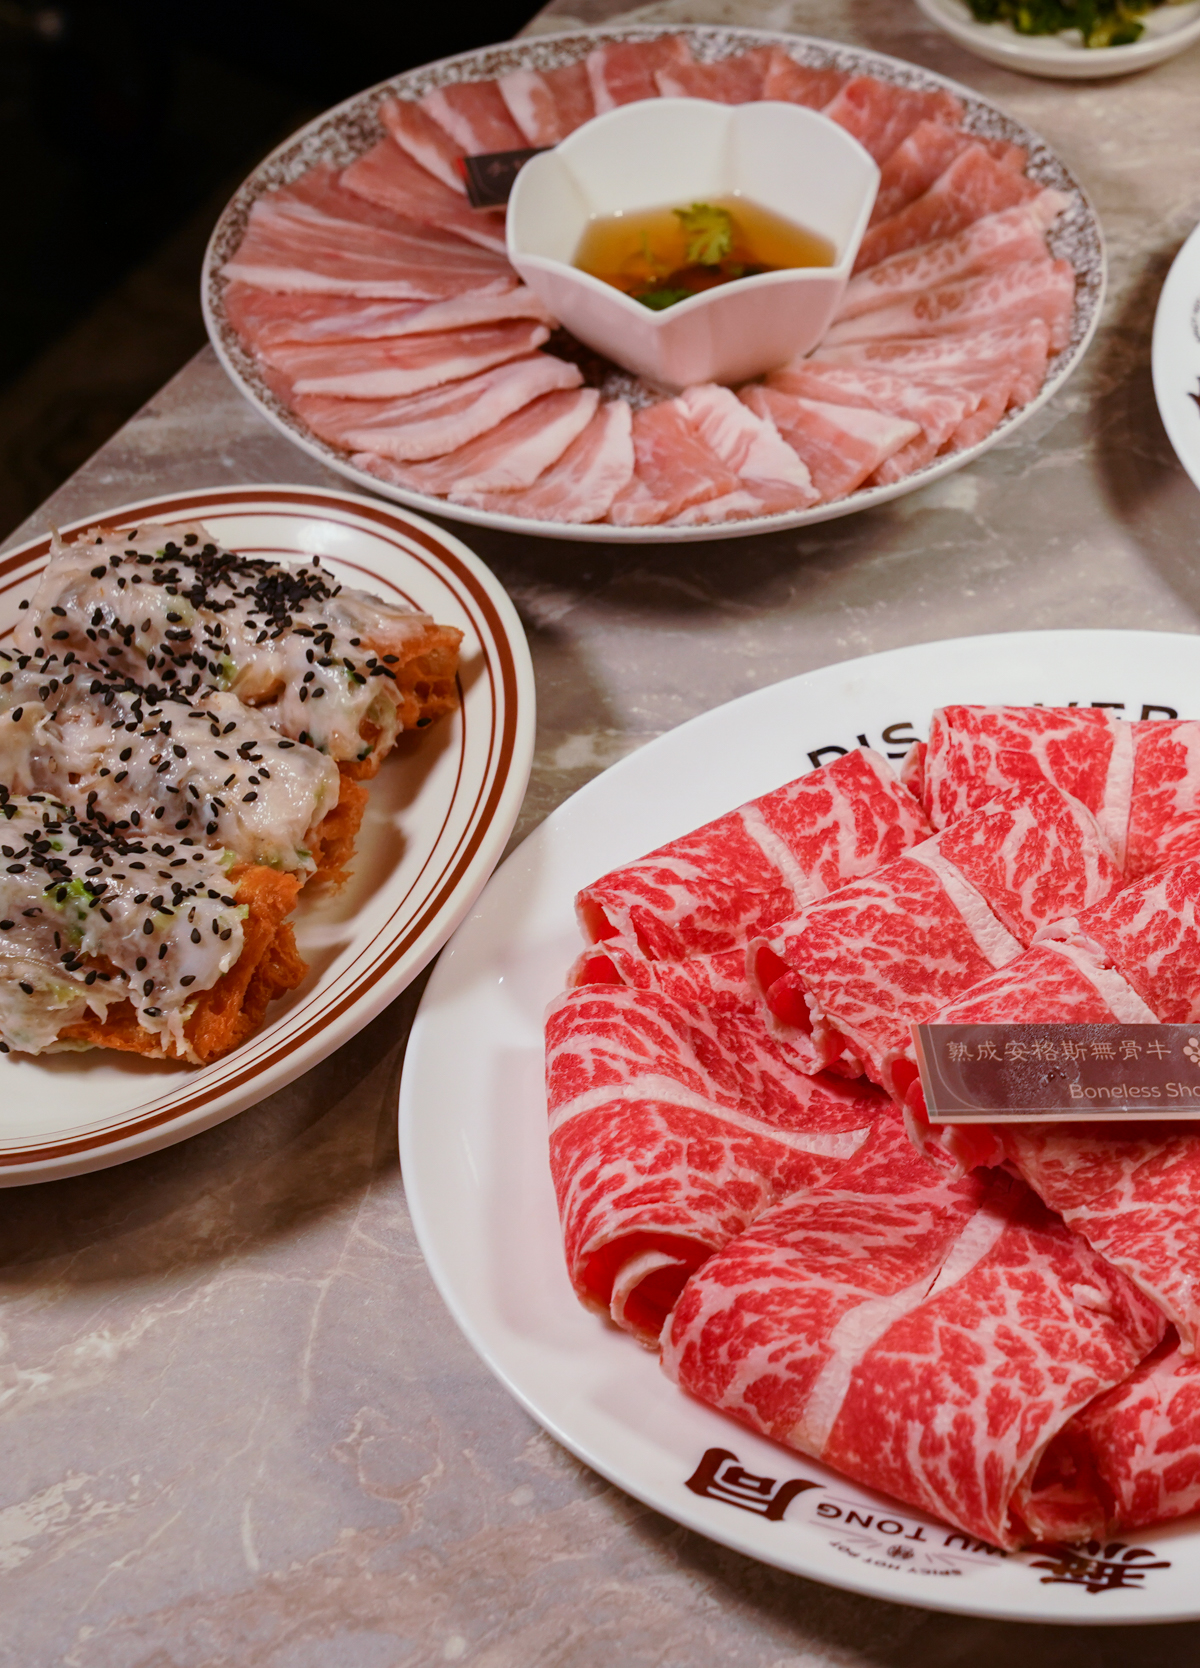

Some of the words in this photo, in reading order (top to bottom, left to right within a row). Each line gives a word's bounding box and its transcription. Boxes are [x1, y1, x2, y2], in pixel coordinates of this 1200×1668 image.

[946, 1039, 1172, 1062] 熟成安格斯無骨牛
[1069, 1082, 1161, 1100] Boneless
[684, 1447, 828, 1522] 同
[816, 1502, 927, 1543] TONG
